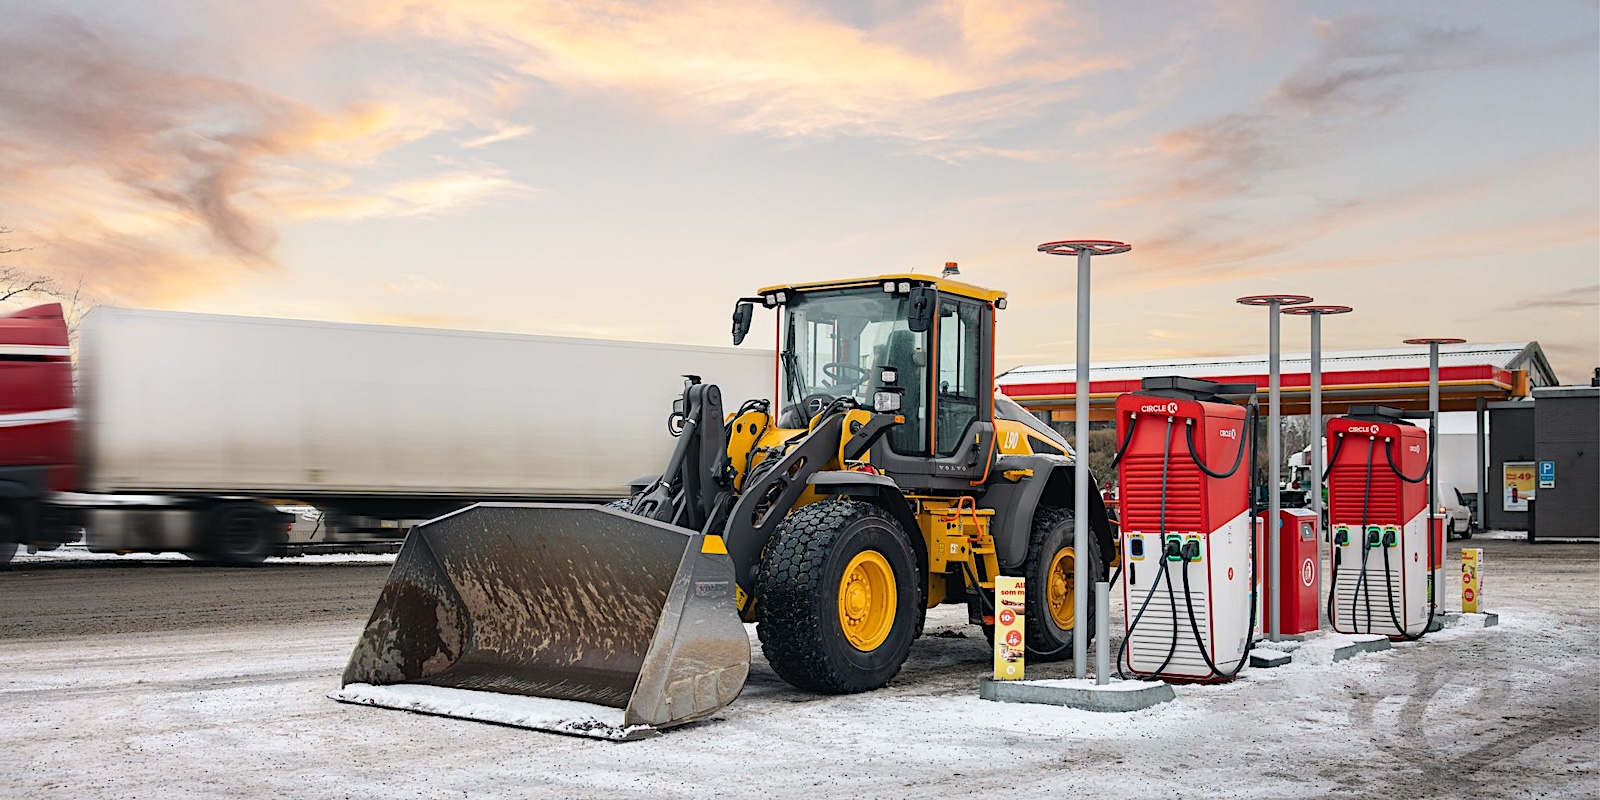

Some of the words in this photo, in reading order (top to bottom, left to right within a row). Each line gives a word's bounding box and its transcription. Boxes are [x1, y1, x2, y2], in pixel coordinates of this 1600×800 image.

[1141, 405, 1167, 413] CIRCLE
[1167, 402, 1178, 414] K
[1370, 424, 1379, 434] K
[1004, 432, 1019, 449] L90
[1543, 463, 1552, 474] P
